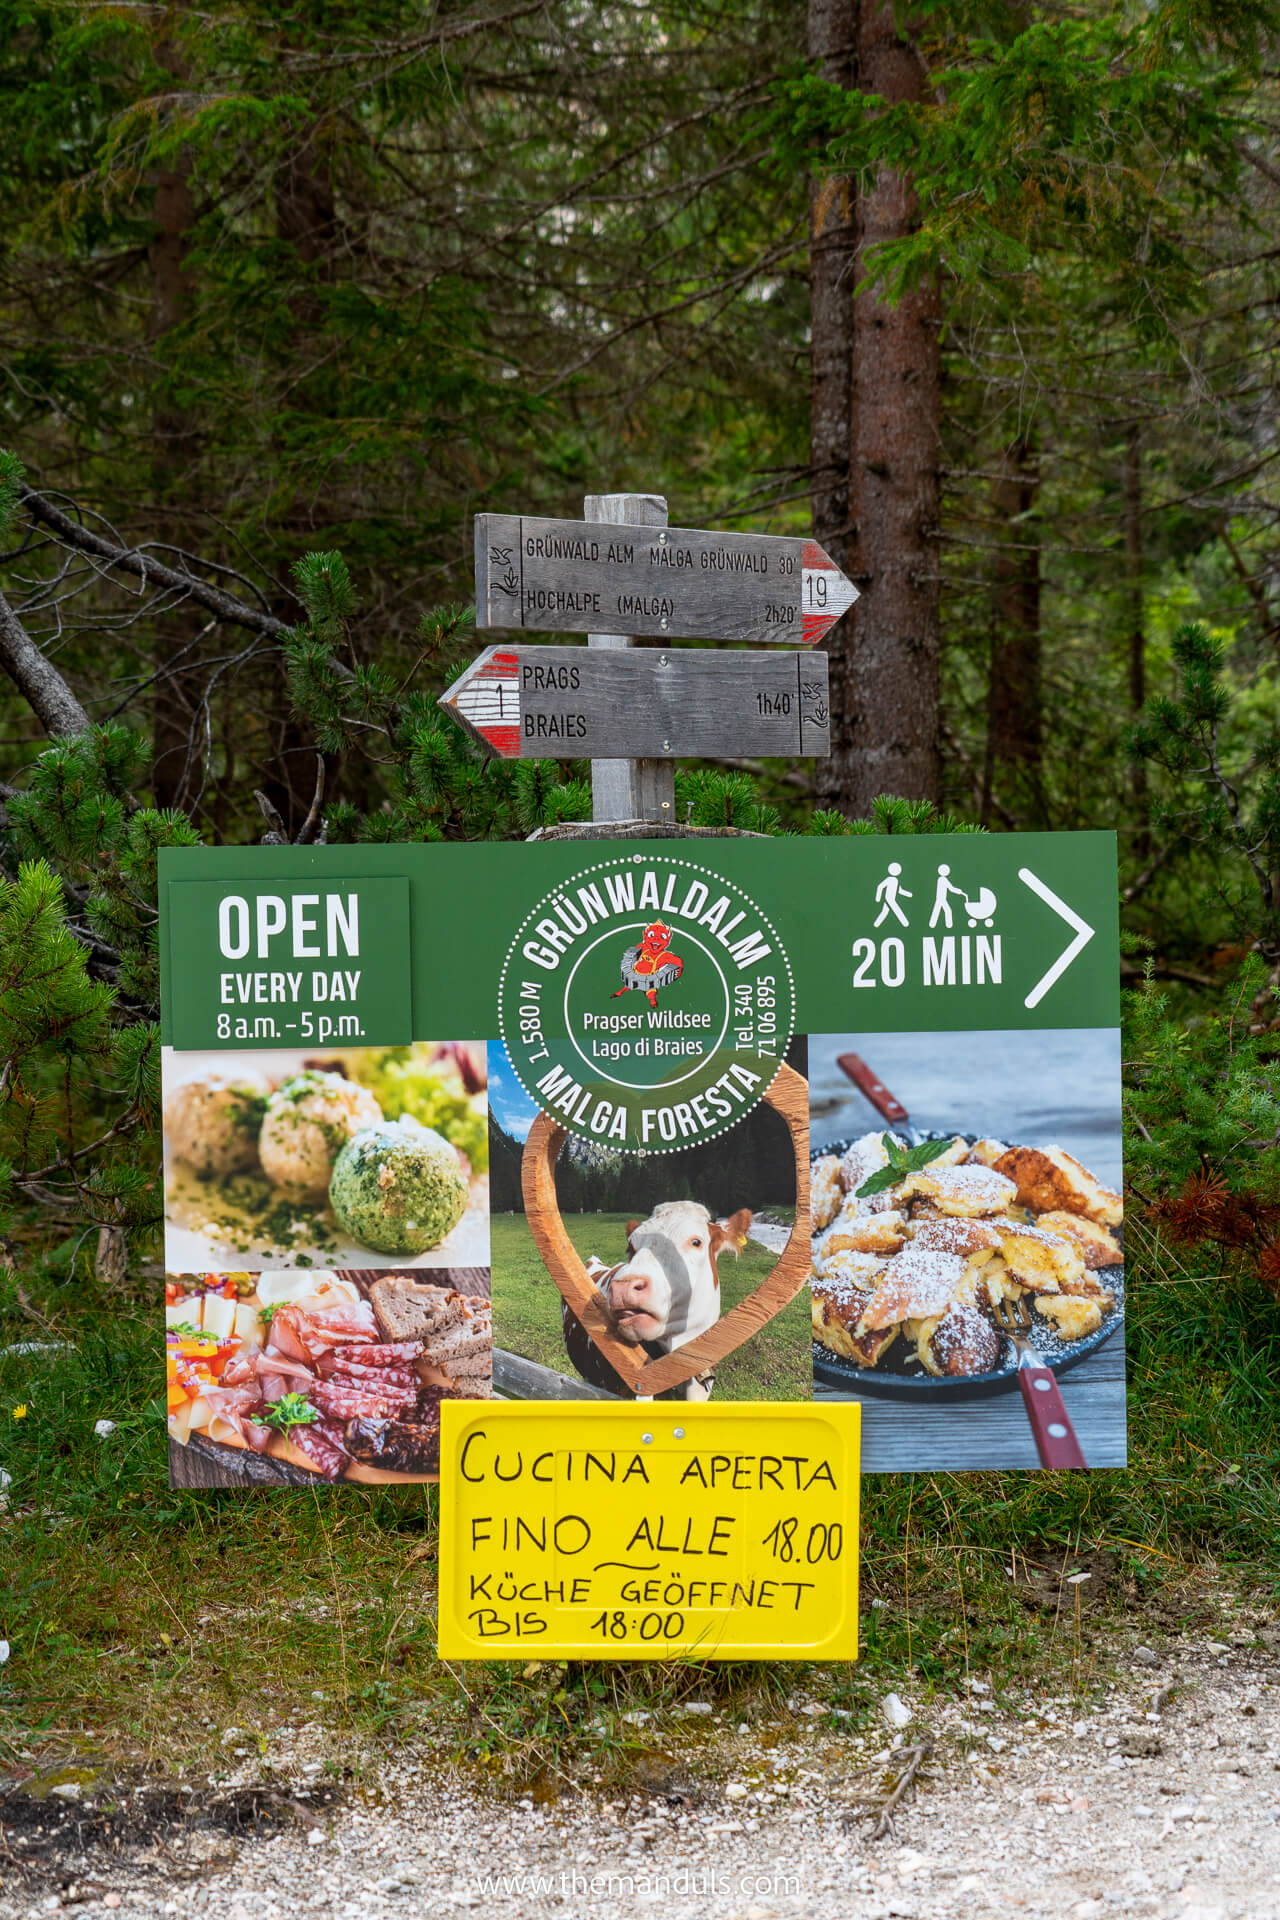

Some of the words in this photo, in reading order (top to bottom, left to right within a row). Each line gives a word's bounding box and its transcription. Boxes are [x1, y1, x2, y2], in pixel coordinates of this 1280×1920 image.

[526, 535, 599, 562] GRÜNWALD
[607, 544, 634, 564] ALM
[649, 548, 693, 570] MALGA
[700, 547, 768, 574] GRÜNWALD
[526, 590, 601, 613] HOCHALPE
[617, 598, 675, 617] (MALGA)
[806, 575, 828, 608] 19
[523, 666, 580, 690] PRAGS
[494, 684, 505, 718] 1
[524, 714, 587, 738] BRAIES
[218, 894, 360, 960] OPEN
[522, 871, 772, 970] GRÜNWALDALM
[852, 937, 906, 988] 20
[922, 935, 1002, 986] MIN
[220, 972, 303, 1004] EVERY
[312, 970, 362, 1002] DAY
[521, 981, 543, 1000] M
[734, 984, 753, 1017] 340
[519, 1004, 550, 1064] 1.580
[583, 1012, 644, 1033] Pragser
[647, 1010, 711, 1029] Wildsee
[733, 1020, 753, 1052] Tel.
[592, 1039, 632, 1060] Lago
[634, 1038, 649, 1056] di
[654, 1038, 703, 1056] Braies
[535, 1063, 627, 1141] MALGA
[641, 1063, 762, 1142] FORESTA
[460, 1431, 649, 1483] CUCINA
[680, 1455, 837, 1491] APERTA
[472, 1514, 591, 1555] FINO
[626, 1515, 737, 1556] ALLE
[762, 1516, 843, 1564] 18.00
[469, 1572, 592, 1603] KÜCHE
[620, 1572, 815, 1610] GEÖFFNET
[468, 1609, 548, 1637] BIS
[590, 1611, 685, 1640] 18:00
